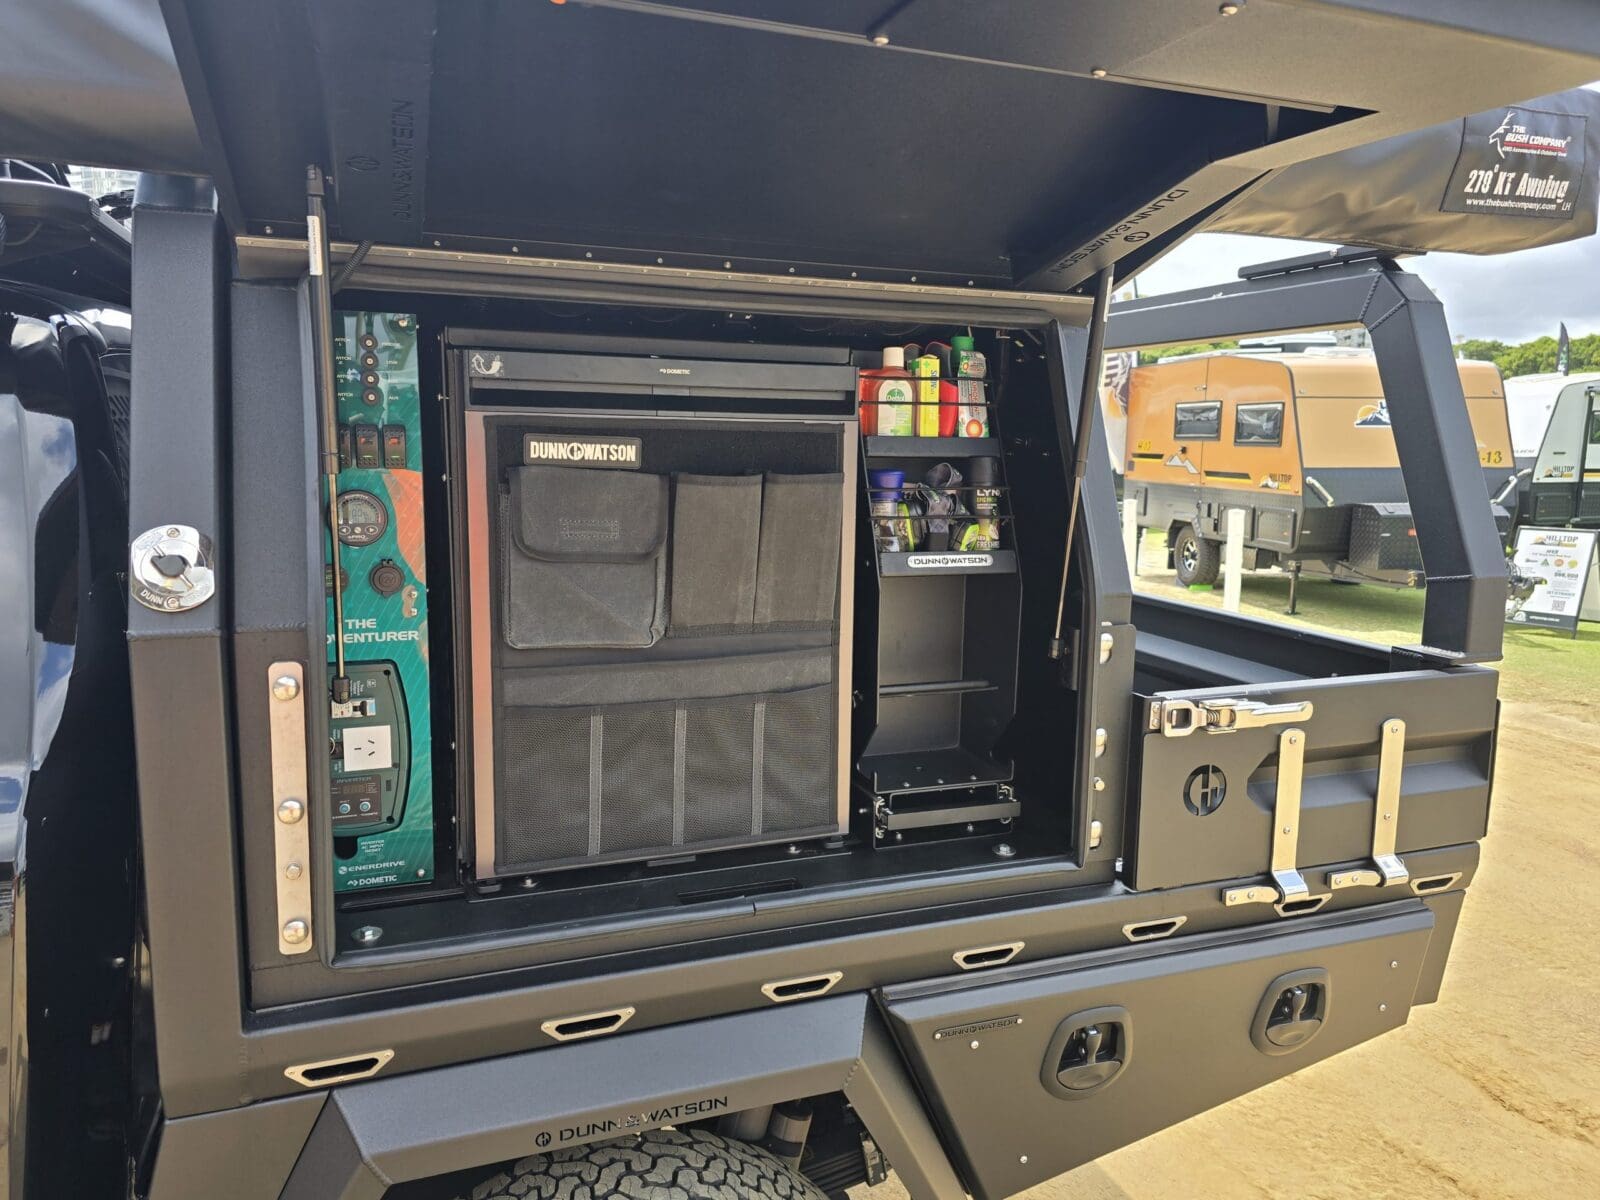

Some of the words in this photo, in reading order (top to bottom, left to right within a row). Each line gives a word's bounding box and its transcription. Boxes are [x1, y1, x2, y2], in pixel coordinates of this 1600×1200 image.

[1512, 125, 1526, 133] THE
[1505, 133, 1529, 143] BUSH
[1529, 135, 1567, 148] COMPANY
[1515, 172, 1569, 203] Awning
[140, 589, 163, 605] DUNN
[345, 618, 377, 630] THE
[348, 860, 405, 872] ENERDRIVE
[359, 875, 398, 886] DOMETIC
